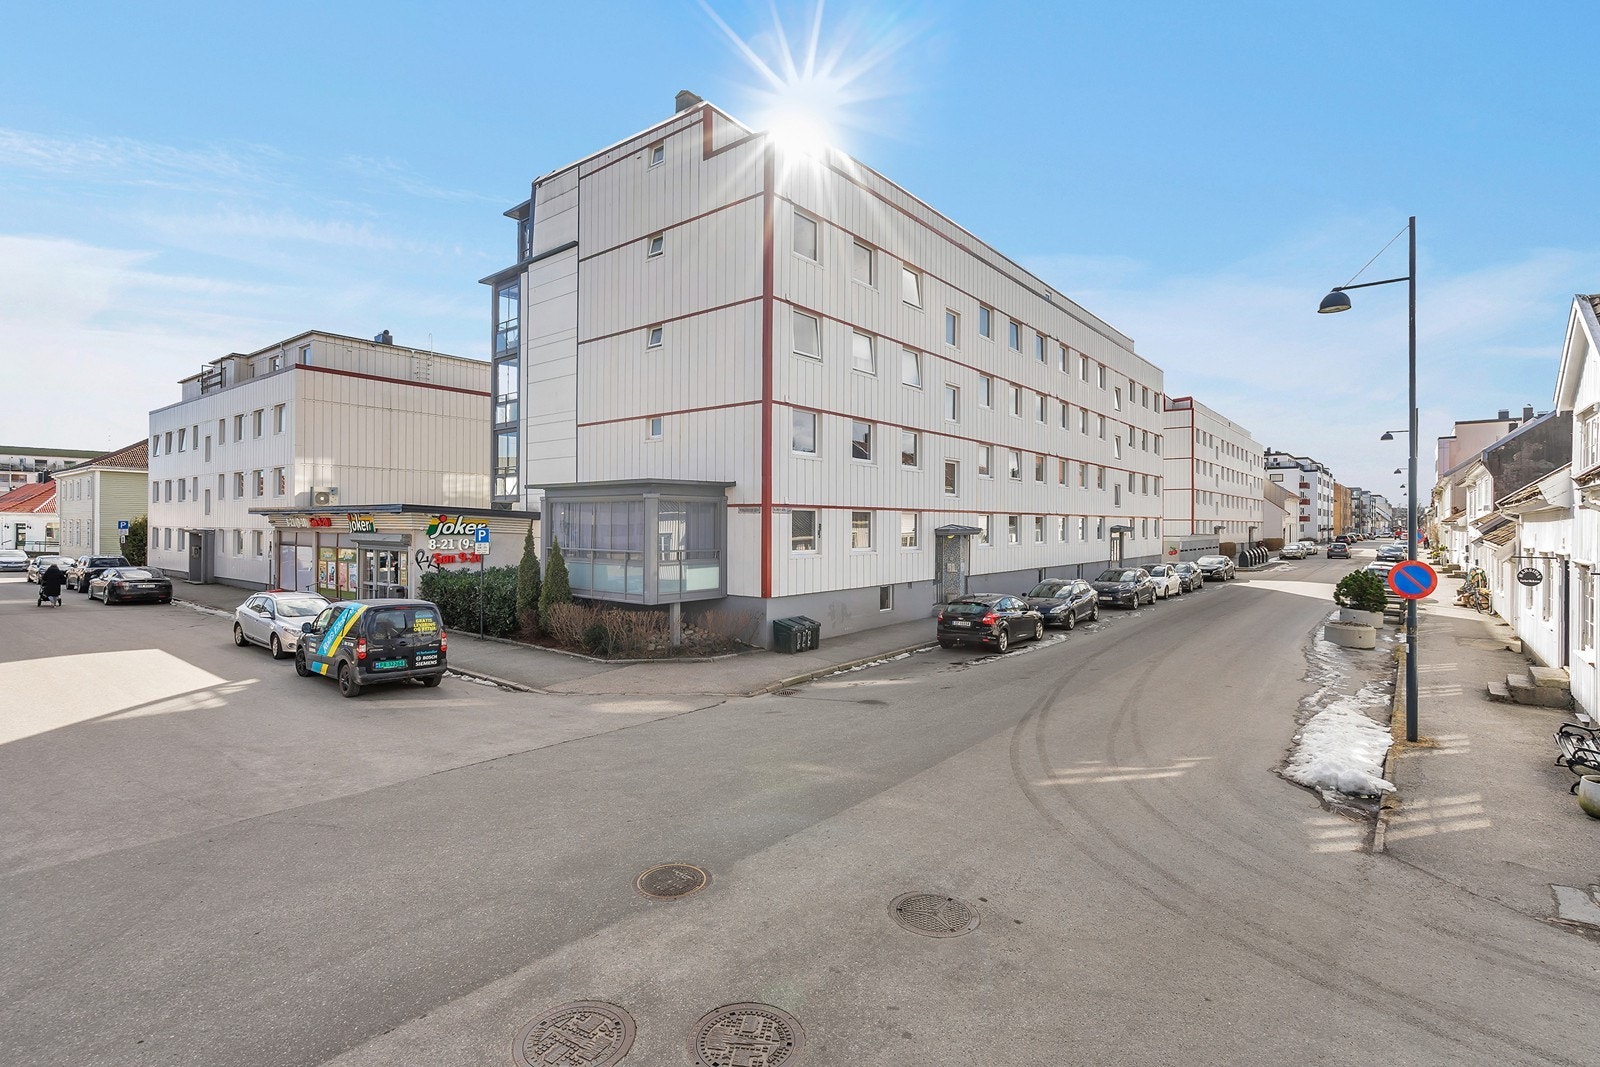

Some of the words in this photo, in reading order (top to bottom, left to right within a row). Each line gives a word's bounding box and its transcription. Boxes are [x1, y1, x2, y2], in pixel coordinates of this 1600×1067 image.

[120, 521, 127, 529] P
[347, 513, 370, 533] joker
[429, 515, 487, 539] joker
[478, 529, 487, 542] P
[429, 539, 455, 550] 8-21
[458, 538, 475, 551] (9-
